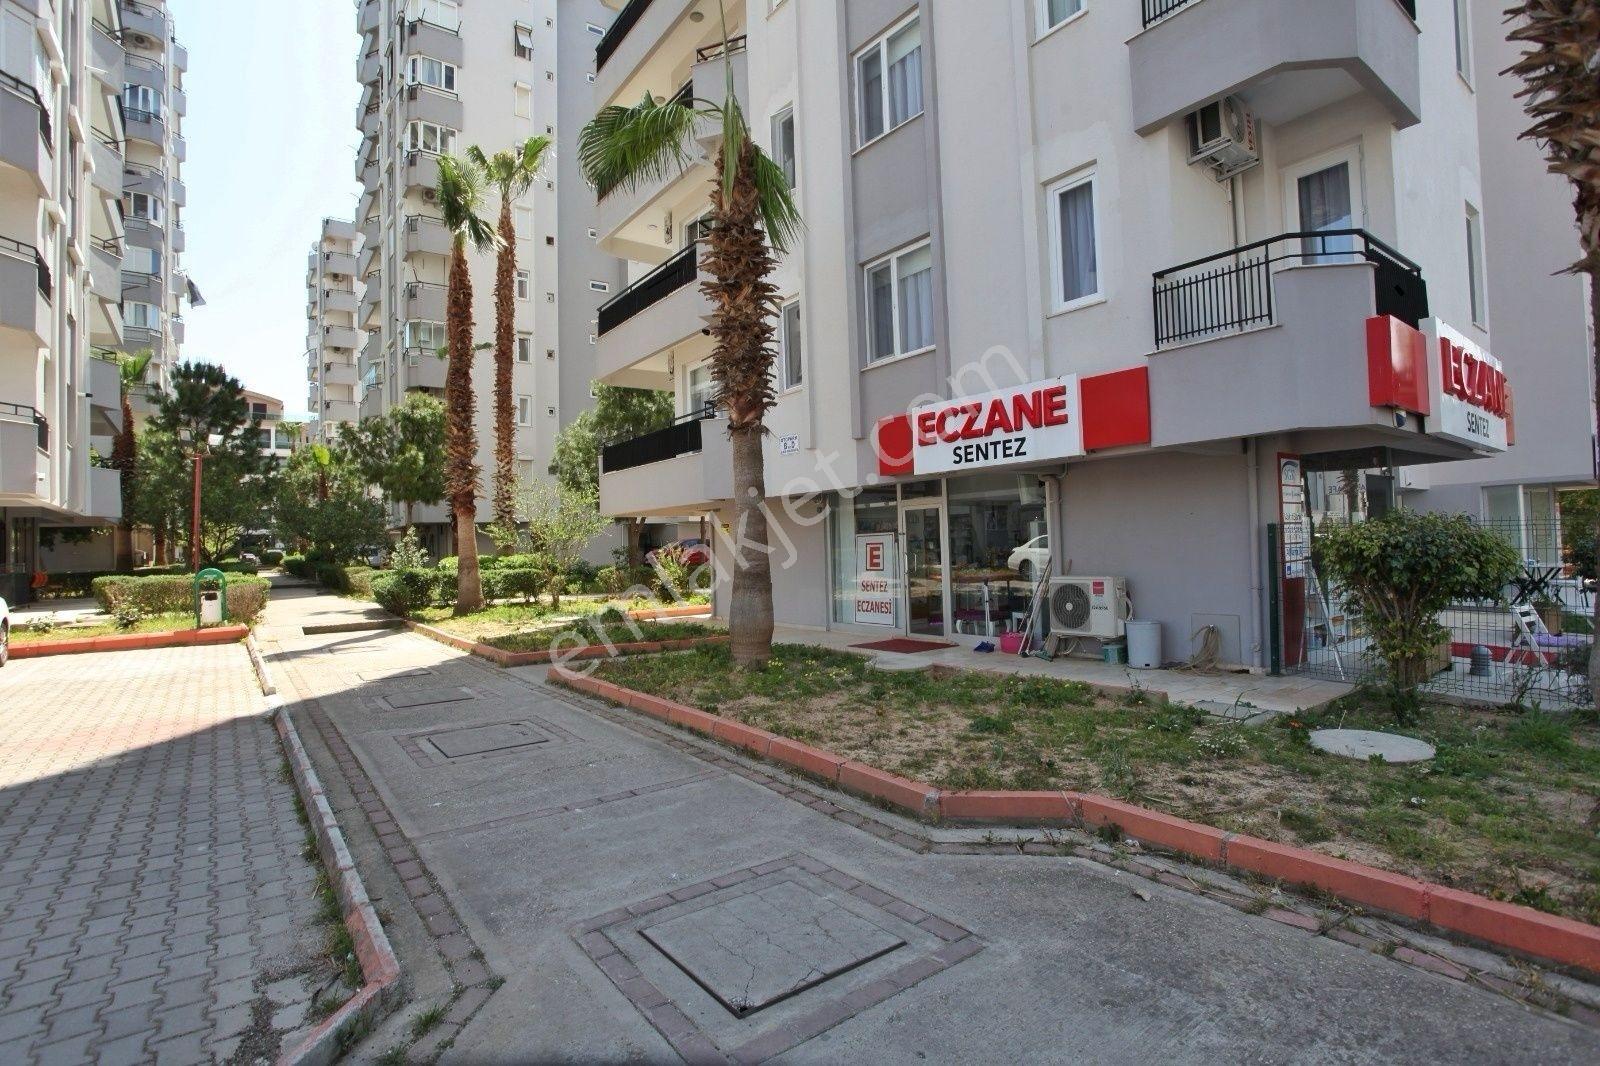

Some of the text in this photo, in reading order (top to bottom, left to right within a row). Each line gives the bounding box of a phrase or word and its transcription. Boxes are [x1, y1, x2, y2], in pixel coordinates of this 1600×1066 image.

[917, 384, 1069, 447] ECZANE
[1466, 411, 1490, 439] SENTEZ
[952, 436, 1027, 465] SENTEZ
[870, 547, 881, 568] E
[861, 580, 888, 593] SENTEZ
[857, 598, 892, 614] ECZANESİ
